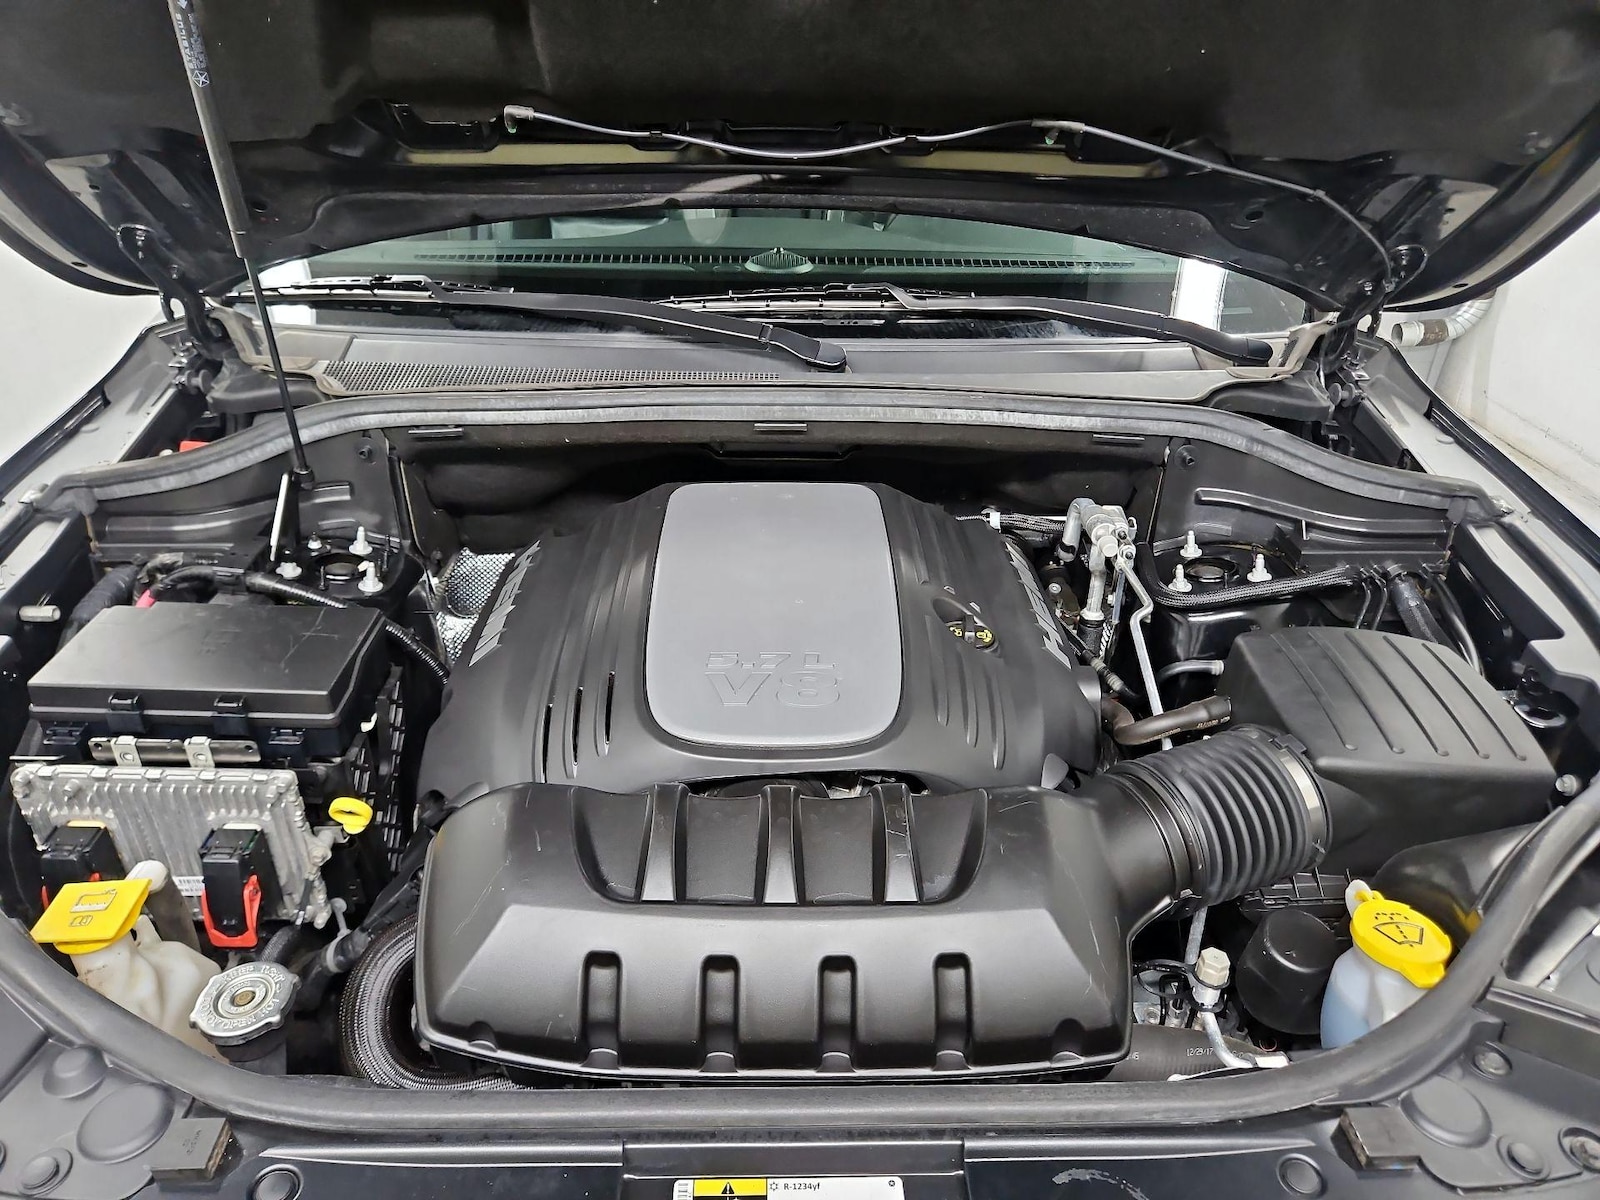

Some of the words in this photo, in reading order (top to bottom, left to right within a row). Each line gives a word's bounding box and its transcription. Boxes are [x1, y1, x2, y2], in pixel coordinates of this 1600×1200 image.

[175, 13, 194, 69] STABILUS
[468, 540, 541, 667] HEMI
[704, 671, 841, 707] V8
[783, 1182, 820, 1191] R-1234yf
